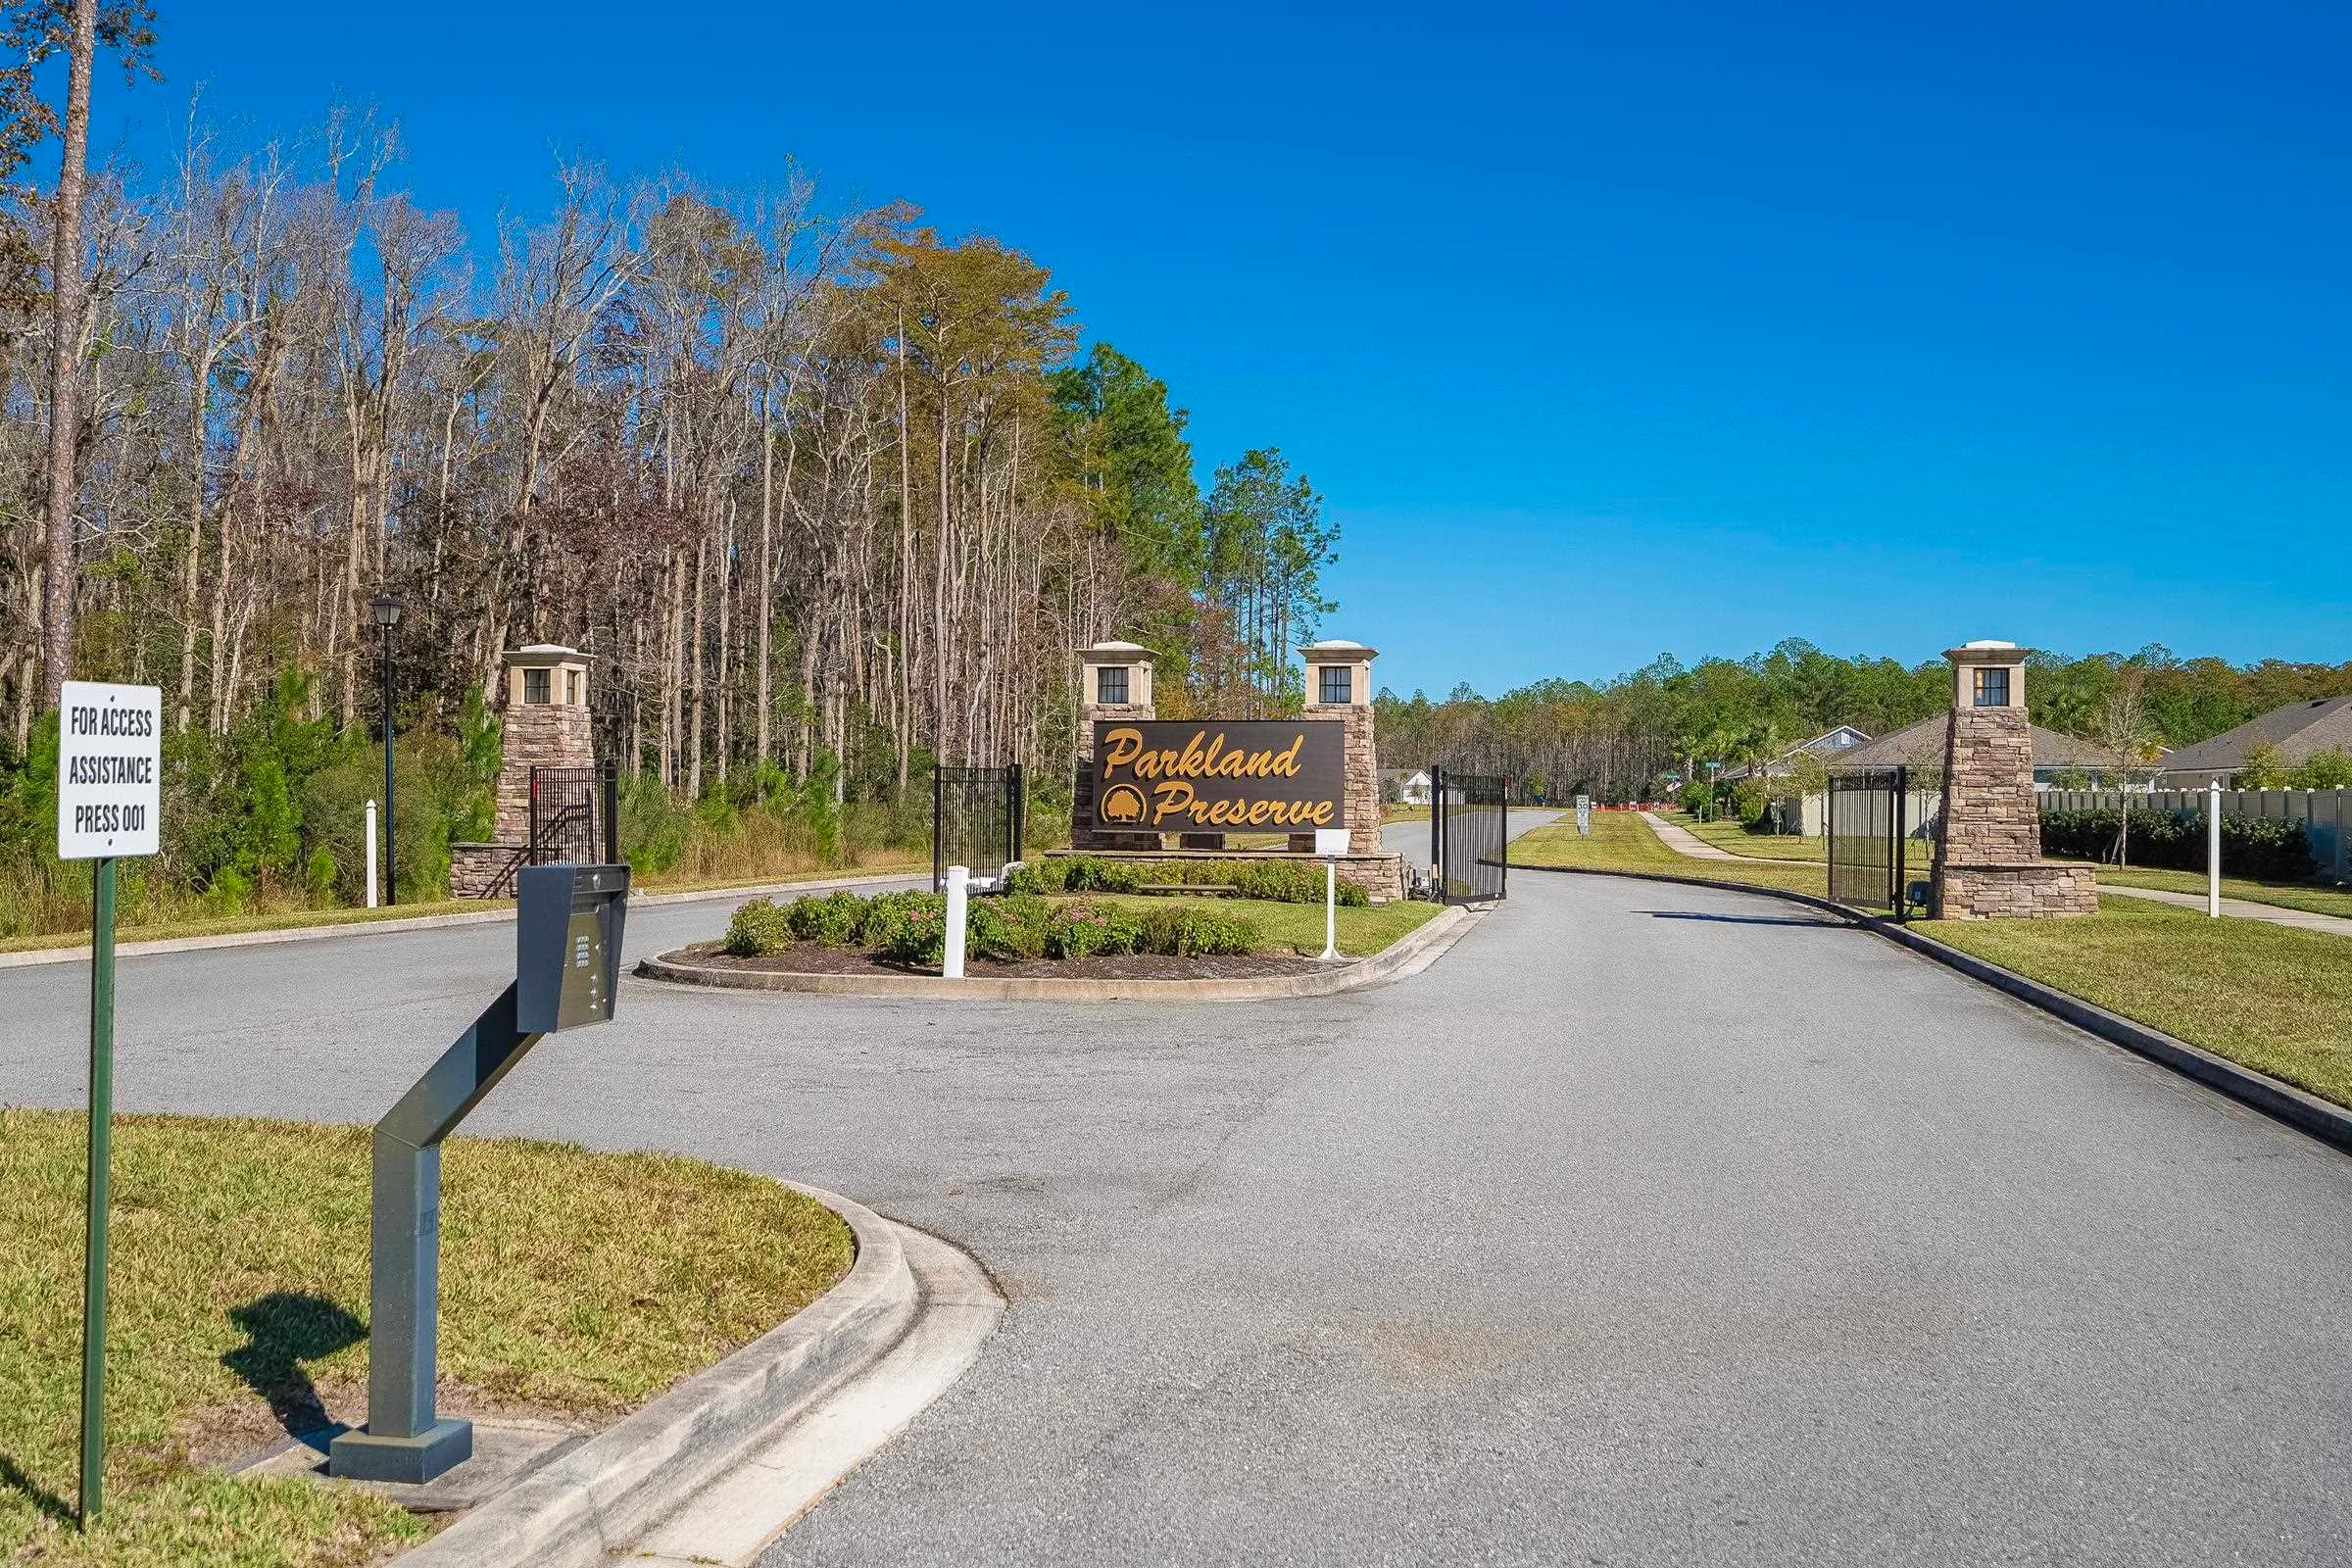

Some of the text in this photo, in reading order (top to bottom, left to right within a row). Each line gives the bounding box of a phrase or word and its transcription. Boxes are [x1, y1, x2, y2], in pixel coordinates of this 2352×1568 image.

[71, 707, 152, 737] FOR ACCESS
[1103, 728, 1304, 779] Parkland
[70, 756, 152, 784] ASSISTANCE
[1152, 781, 1334, 825] Preserve
[75, 805, 145, 833] PRESS 001
